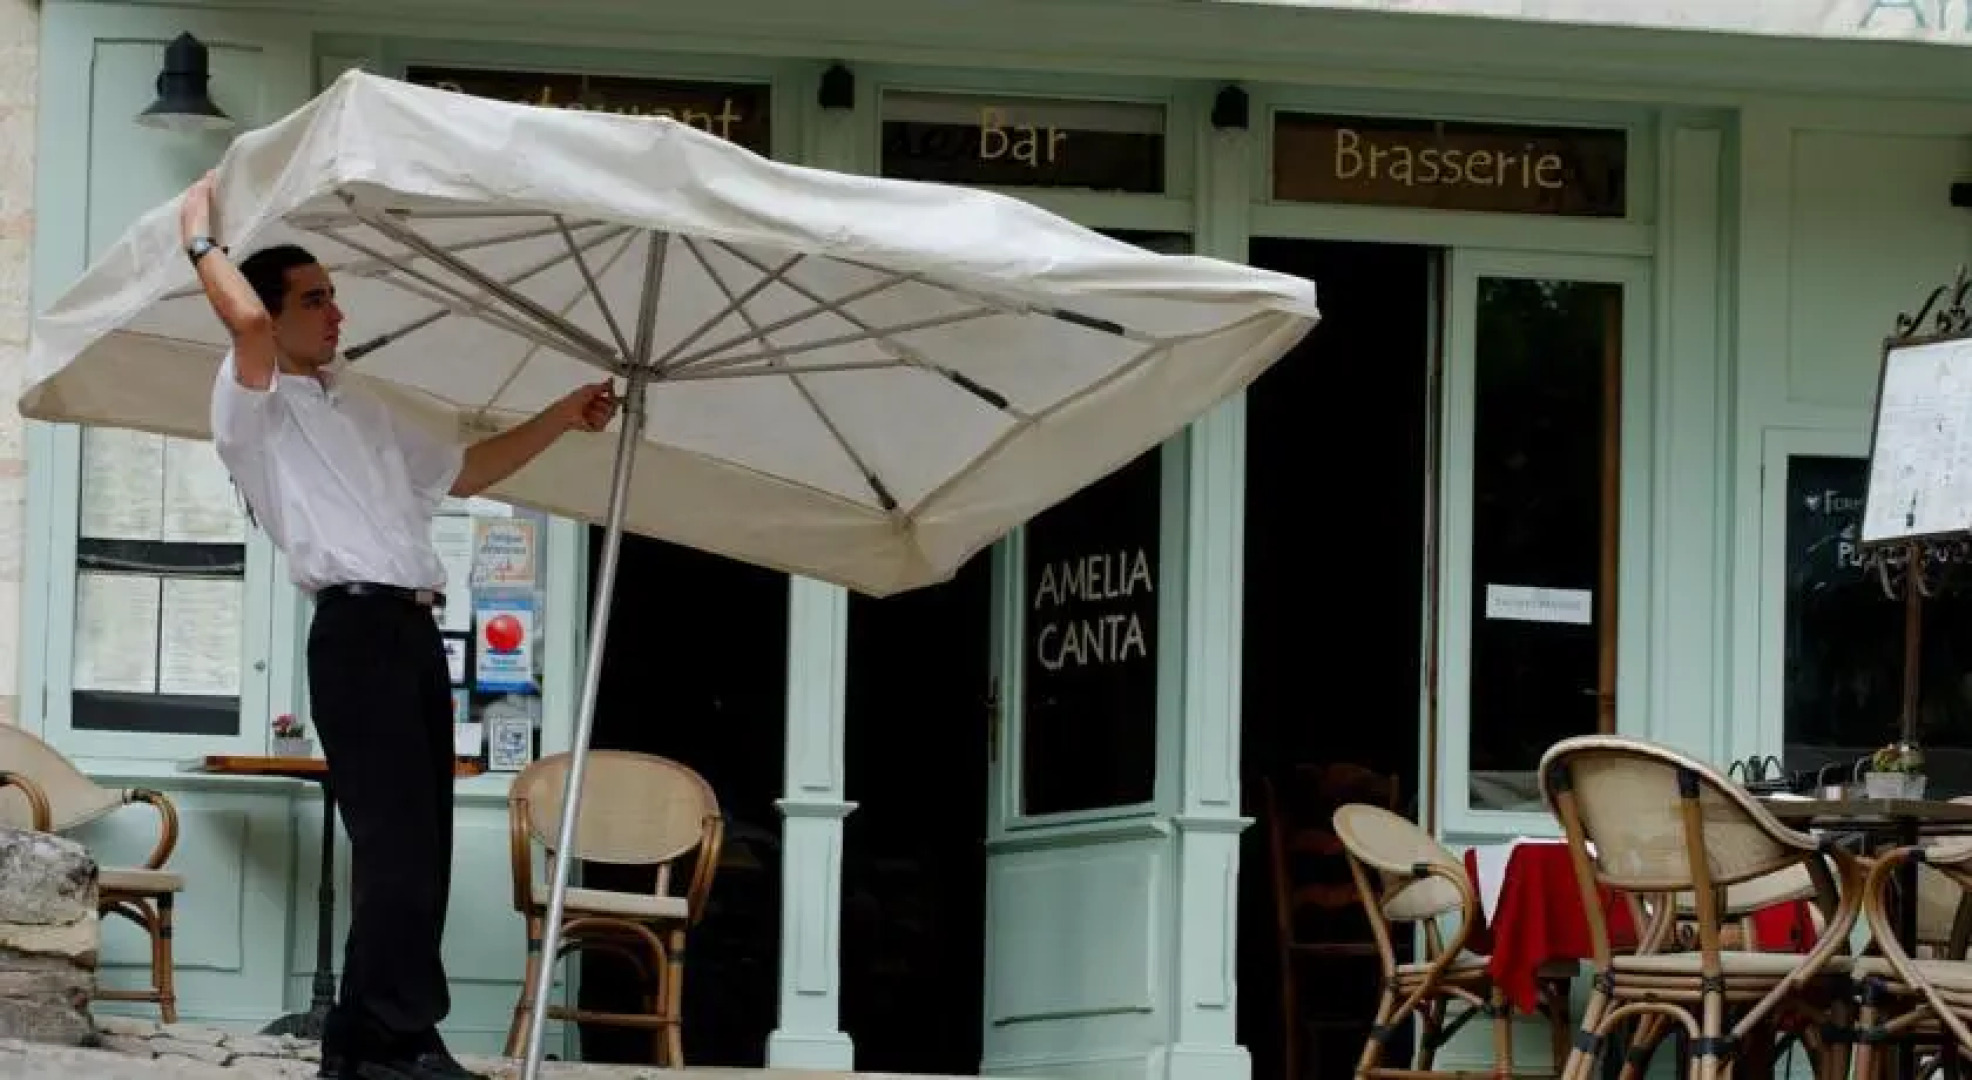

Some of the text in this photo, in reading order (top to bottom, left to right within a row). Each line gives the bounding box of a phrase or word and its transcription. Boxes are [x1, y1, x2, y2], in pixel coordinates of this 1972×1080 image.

[978, 104, 1067, 168] Bar
[1334, 128, 1563, 189] Brasserie
[1034, 547, 1153, 610] AMELIA
[1037, 612, 1147, 670] CANTA
